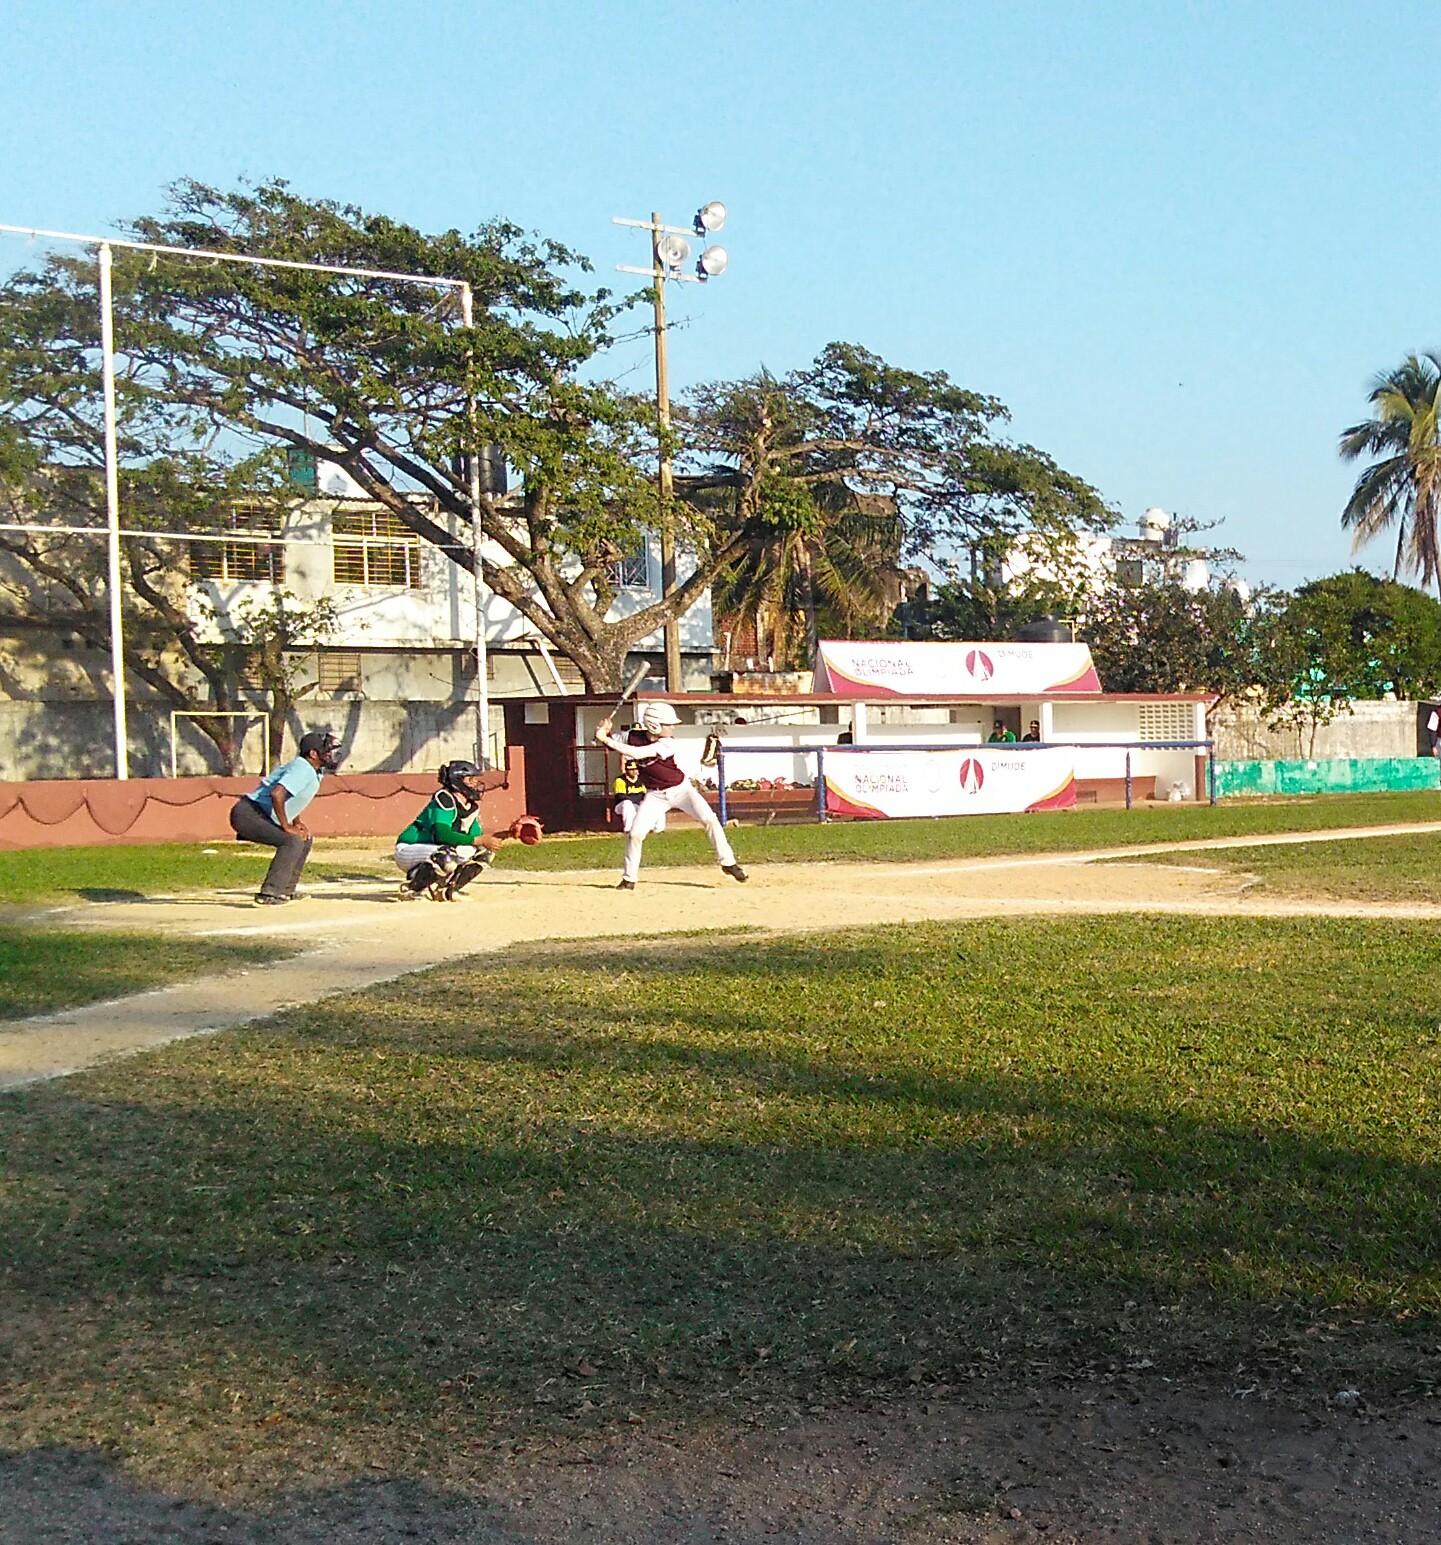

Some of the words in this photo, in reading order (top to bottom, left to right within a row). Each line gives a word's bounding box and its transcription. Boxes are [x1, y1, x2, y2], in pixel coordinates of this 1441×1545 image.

[851, 658, 912, 668] NACIONAL
[854, 667, 914, 676] OLIMPIADA
[991, 761, 1026, 771] DIMUDE
[855, 774, 908, 784] NACIONAL
[855, 784, 909, 793] OLIMPIADA
